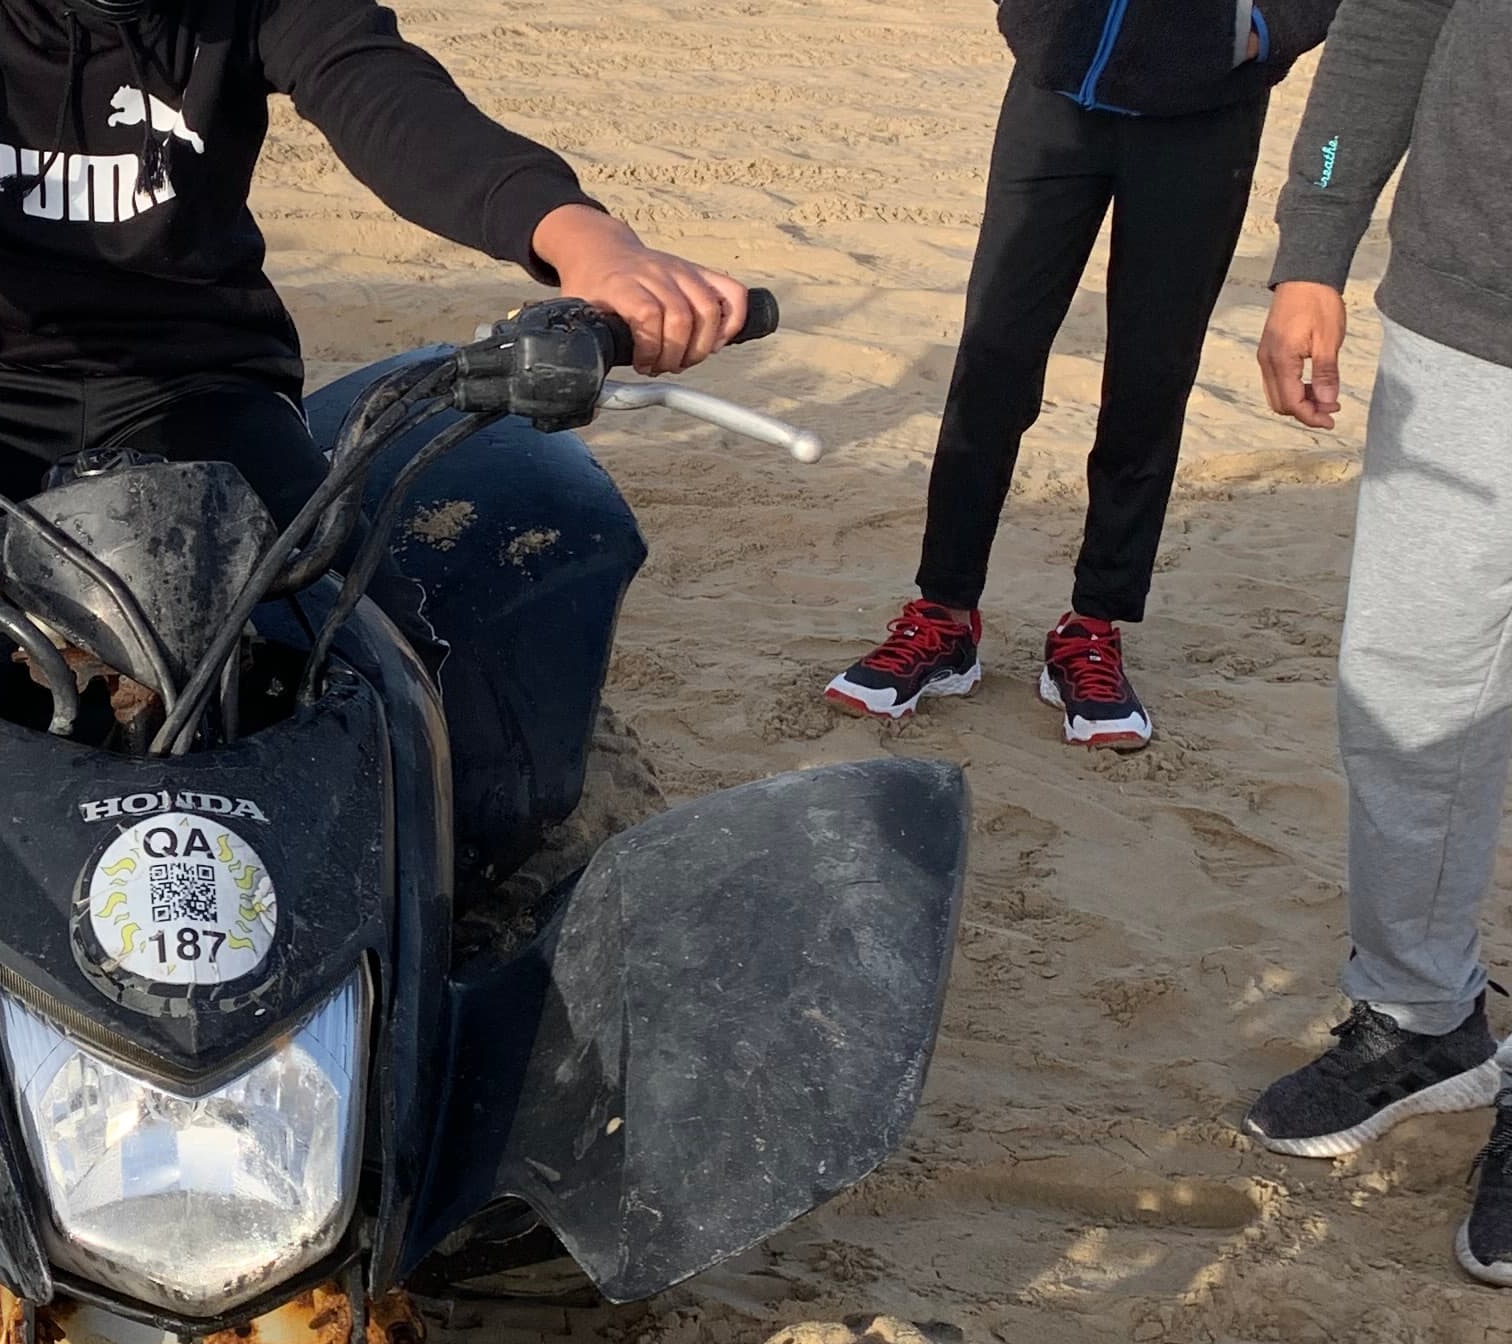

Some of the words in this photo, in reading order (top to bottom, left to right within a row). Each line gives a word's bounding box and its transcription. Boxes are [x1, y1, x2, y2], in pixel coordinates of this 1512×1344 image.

[79, 790, 272, 824] HONDA
[143, 827, 216, 860] QA
[149, 927, 227, 964] 187
